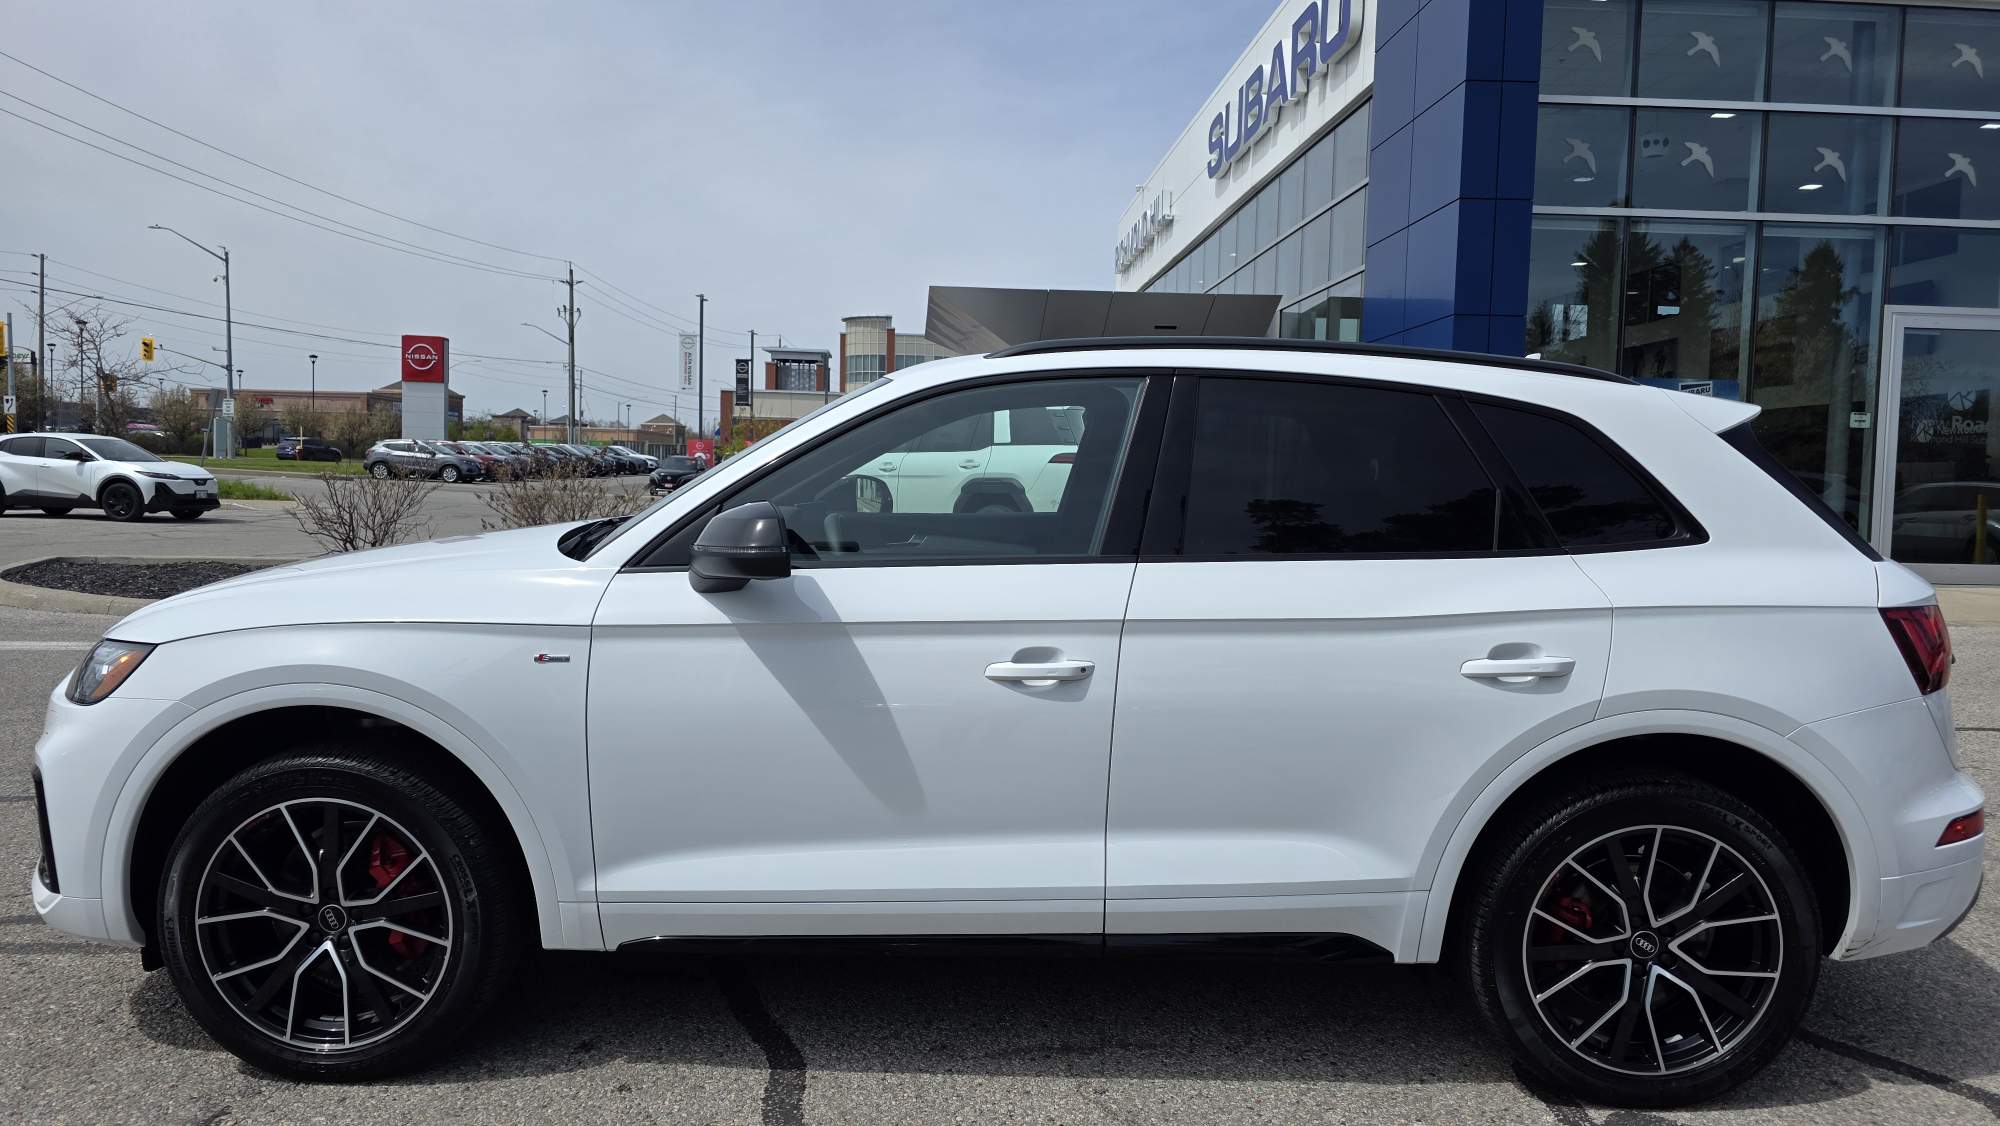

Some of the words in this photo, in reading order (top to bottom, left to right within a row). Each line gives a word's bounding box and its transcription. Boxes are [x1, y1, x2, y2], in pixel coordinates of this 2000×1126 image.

[1207, 0, 1358, 180] SUBARU
[405, 353, 438, 361] NISSAN
[1681, 386, 1711, 396] BARU
